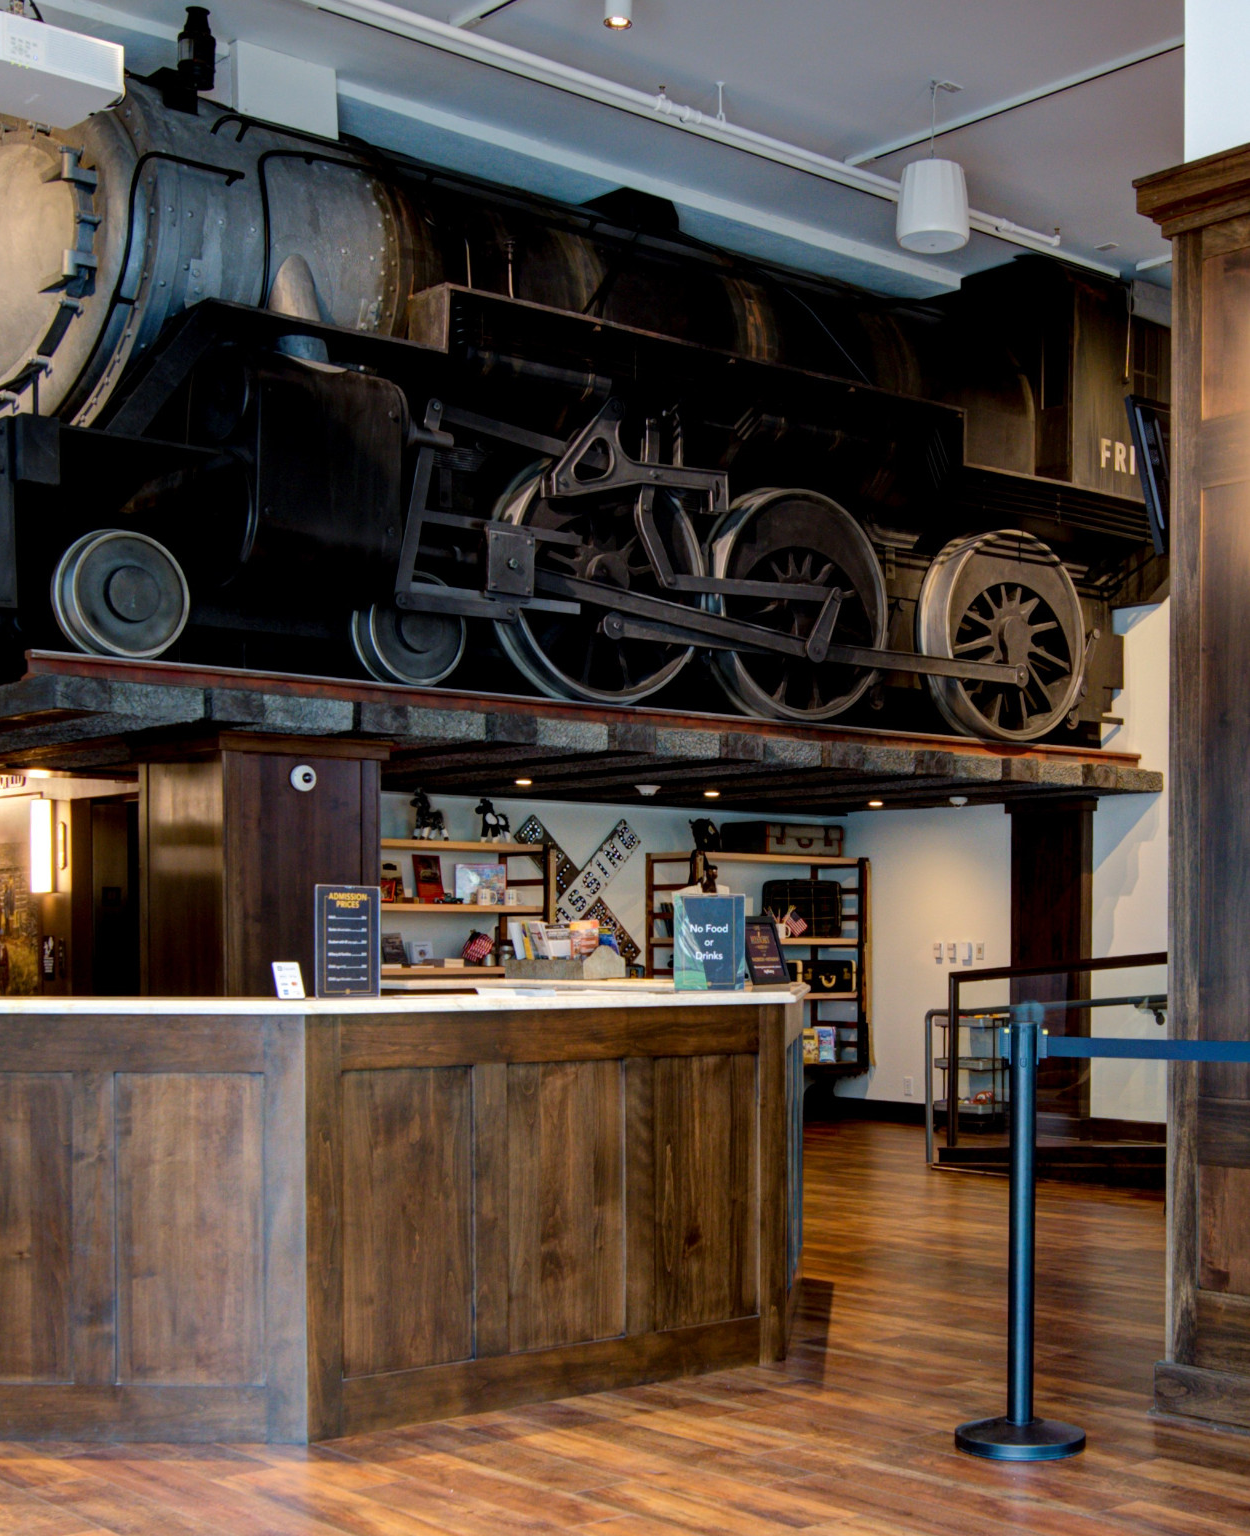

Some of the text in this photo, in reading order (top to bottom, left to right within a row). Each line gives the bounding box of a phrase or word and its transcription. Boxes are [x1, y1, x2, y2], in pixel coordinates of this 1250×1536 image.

[328, 892, 368, 901] ADMISSION
[336, 900, 360, 908] PRICES
[690, 923, 729, 933] No Food
[704, 939, 714, 947] or
[695, 951, 723, 960] Drinks
